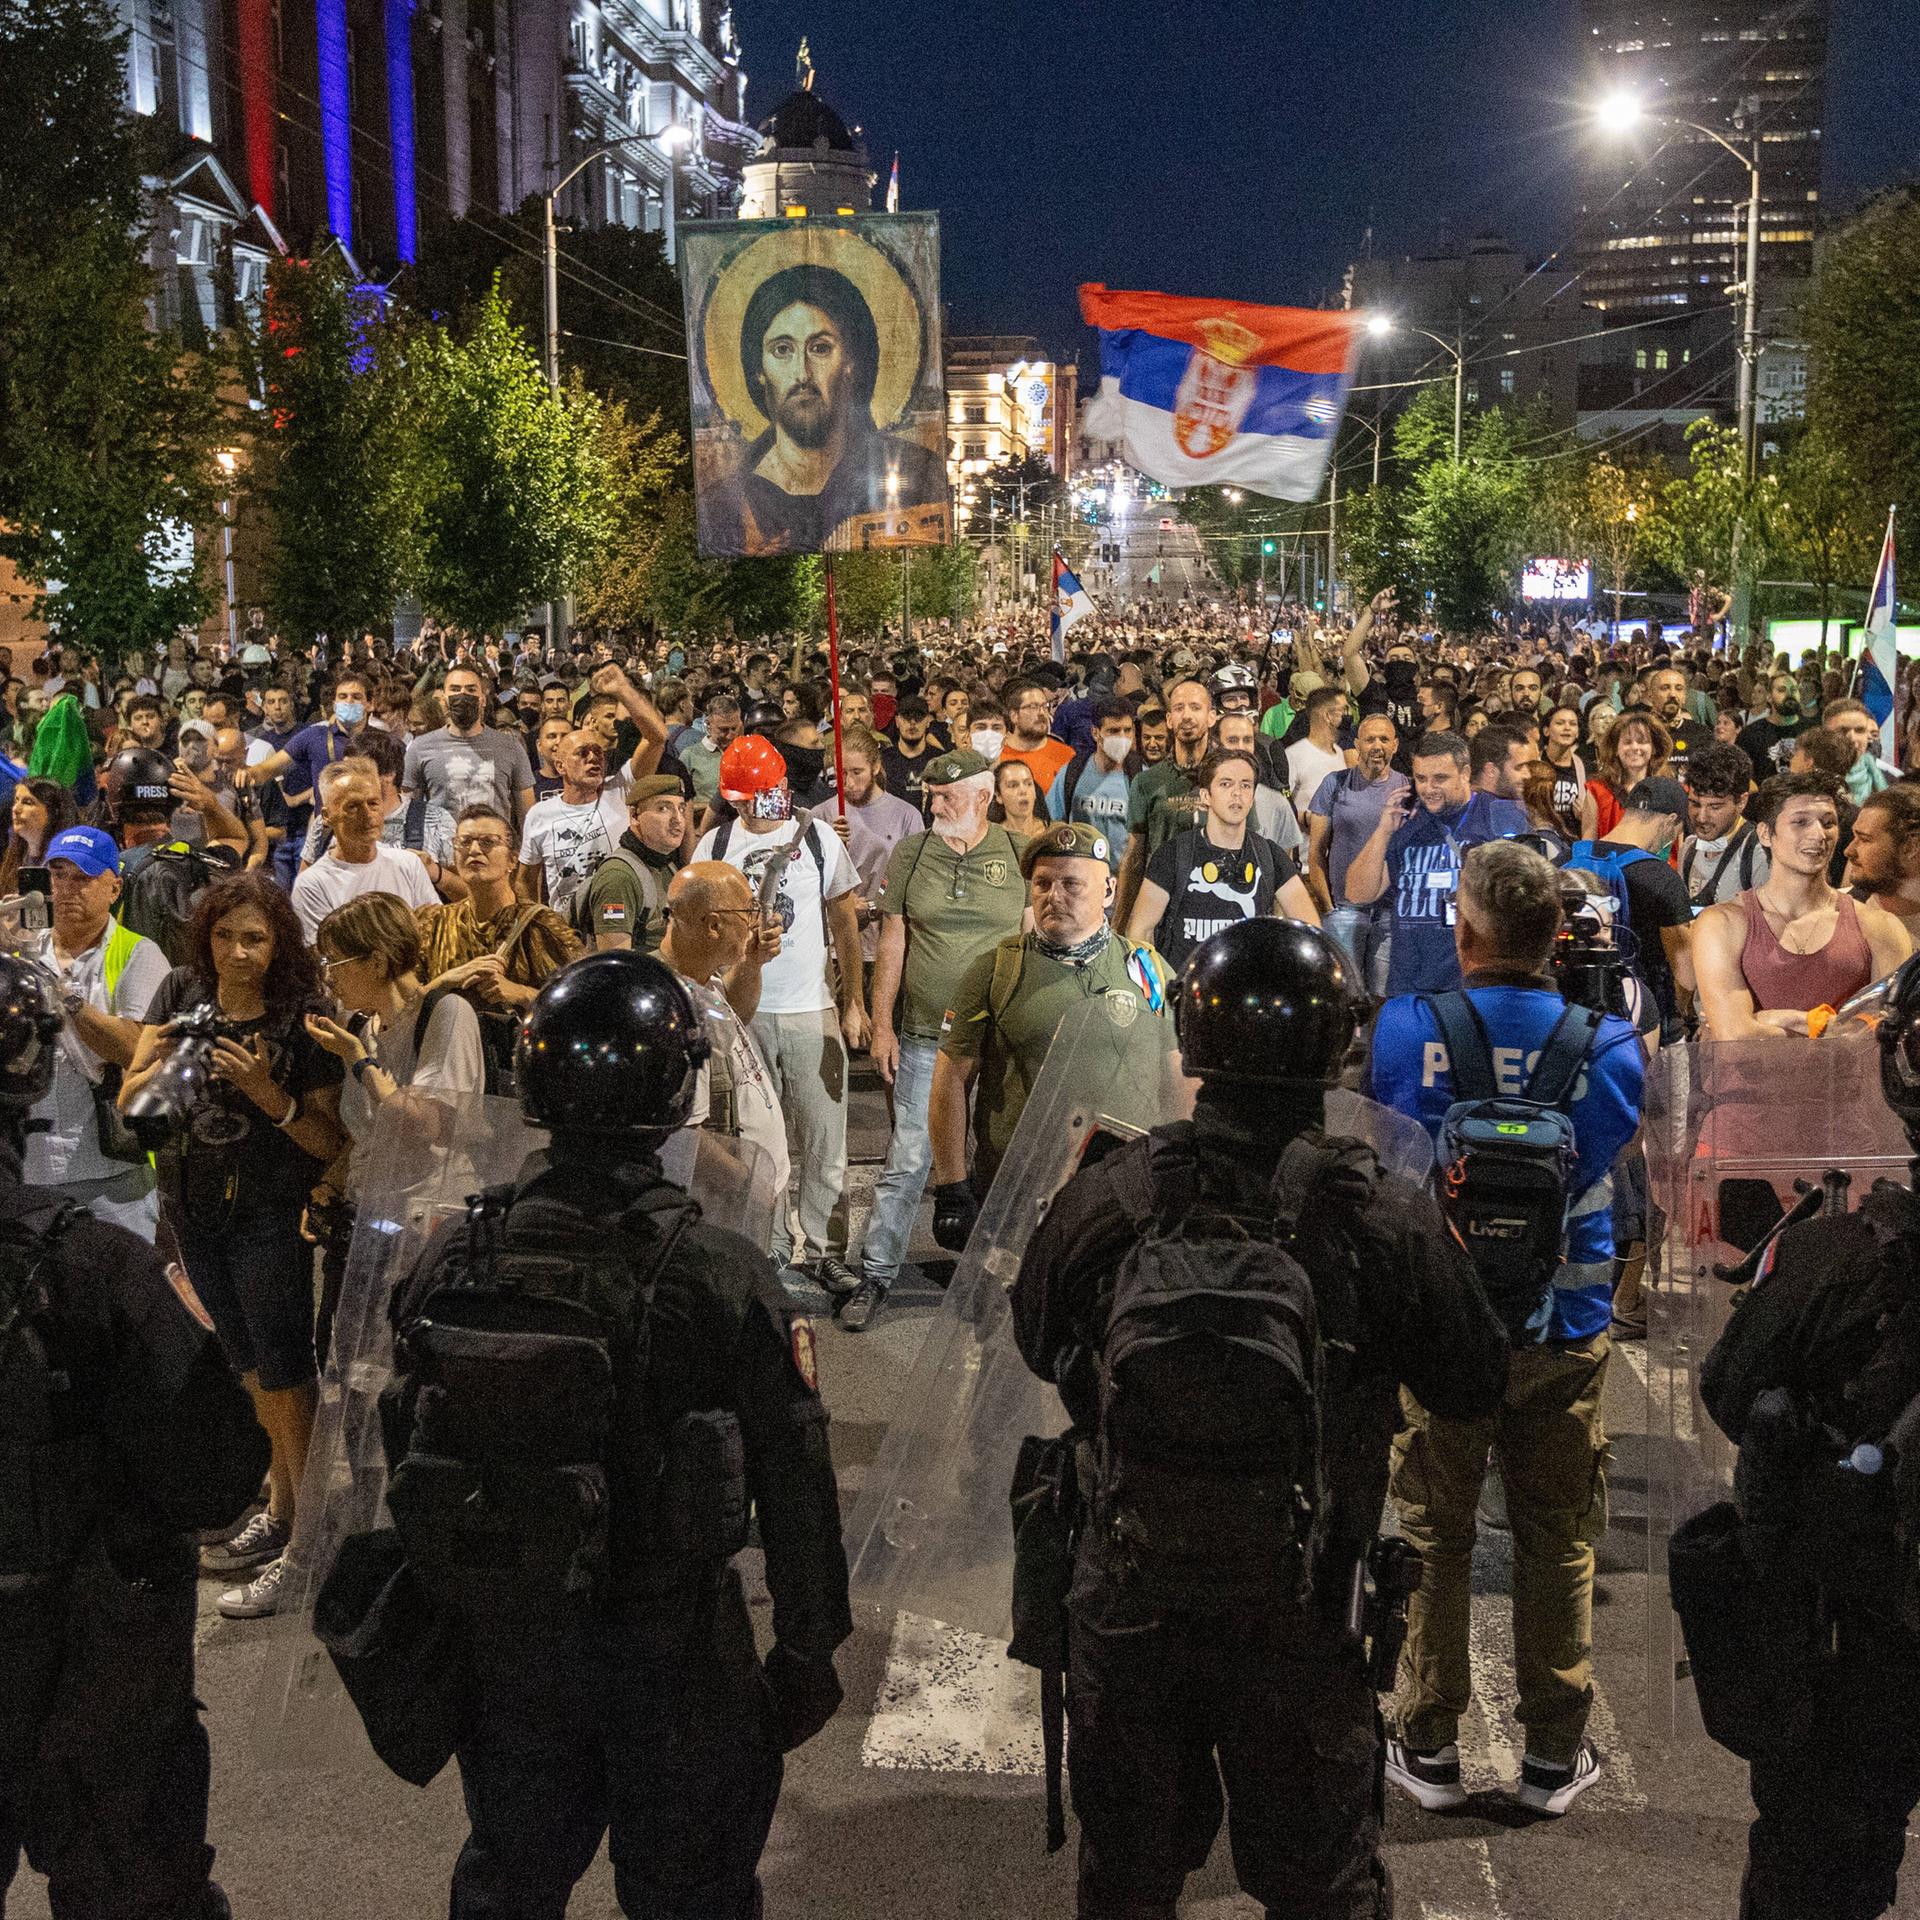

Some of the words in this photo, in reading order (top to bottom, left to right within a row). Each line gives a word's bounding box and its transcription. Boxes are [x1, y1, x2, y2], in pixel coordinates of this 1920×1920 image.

[135, 785, 169, 798] PRESS
[61, 834, 95, 848] PRESS
[1183, 917, 1247, 942] PUM
